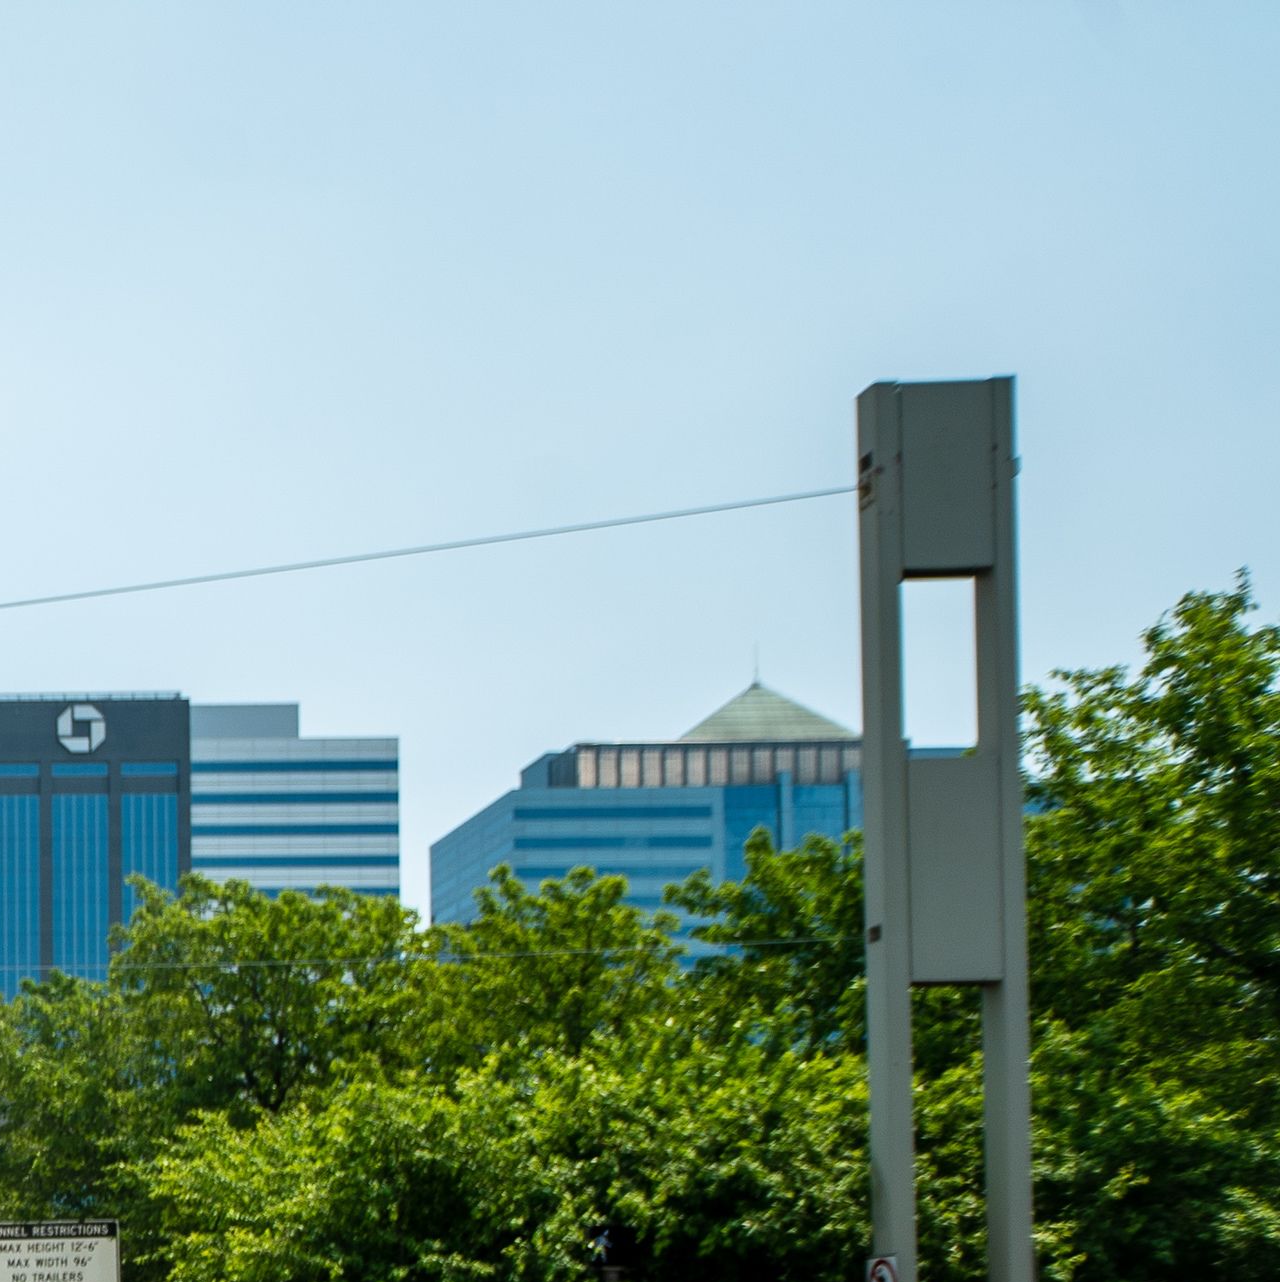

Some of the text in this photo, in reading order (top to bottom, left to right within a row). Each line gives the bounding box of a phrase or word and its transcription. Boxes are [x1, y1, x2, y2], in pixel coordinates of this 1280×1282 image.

[32, 1224, 109, 1236] RESTRICTIONS
[0, 1243, 22, 1253] MAX
[27, 1242, 65, 1253] HEIGHT
[7, 1258, 30, 1268] MAX
[35, 1257, 68, 1268] WIDTH
[12, 1272, 84, 1282] NO TRAILERS
